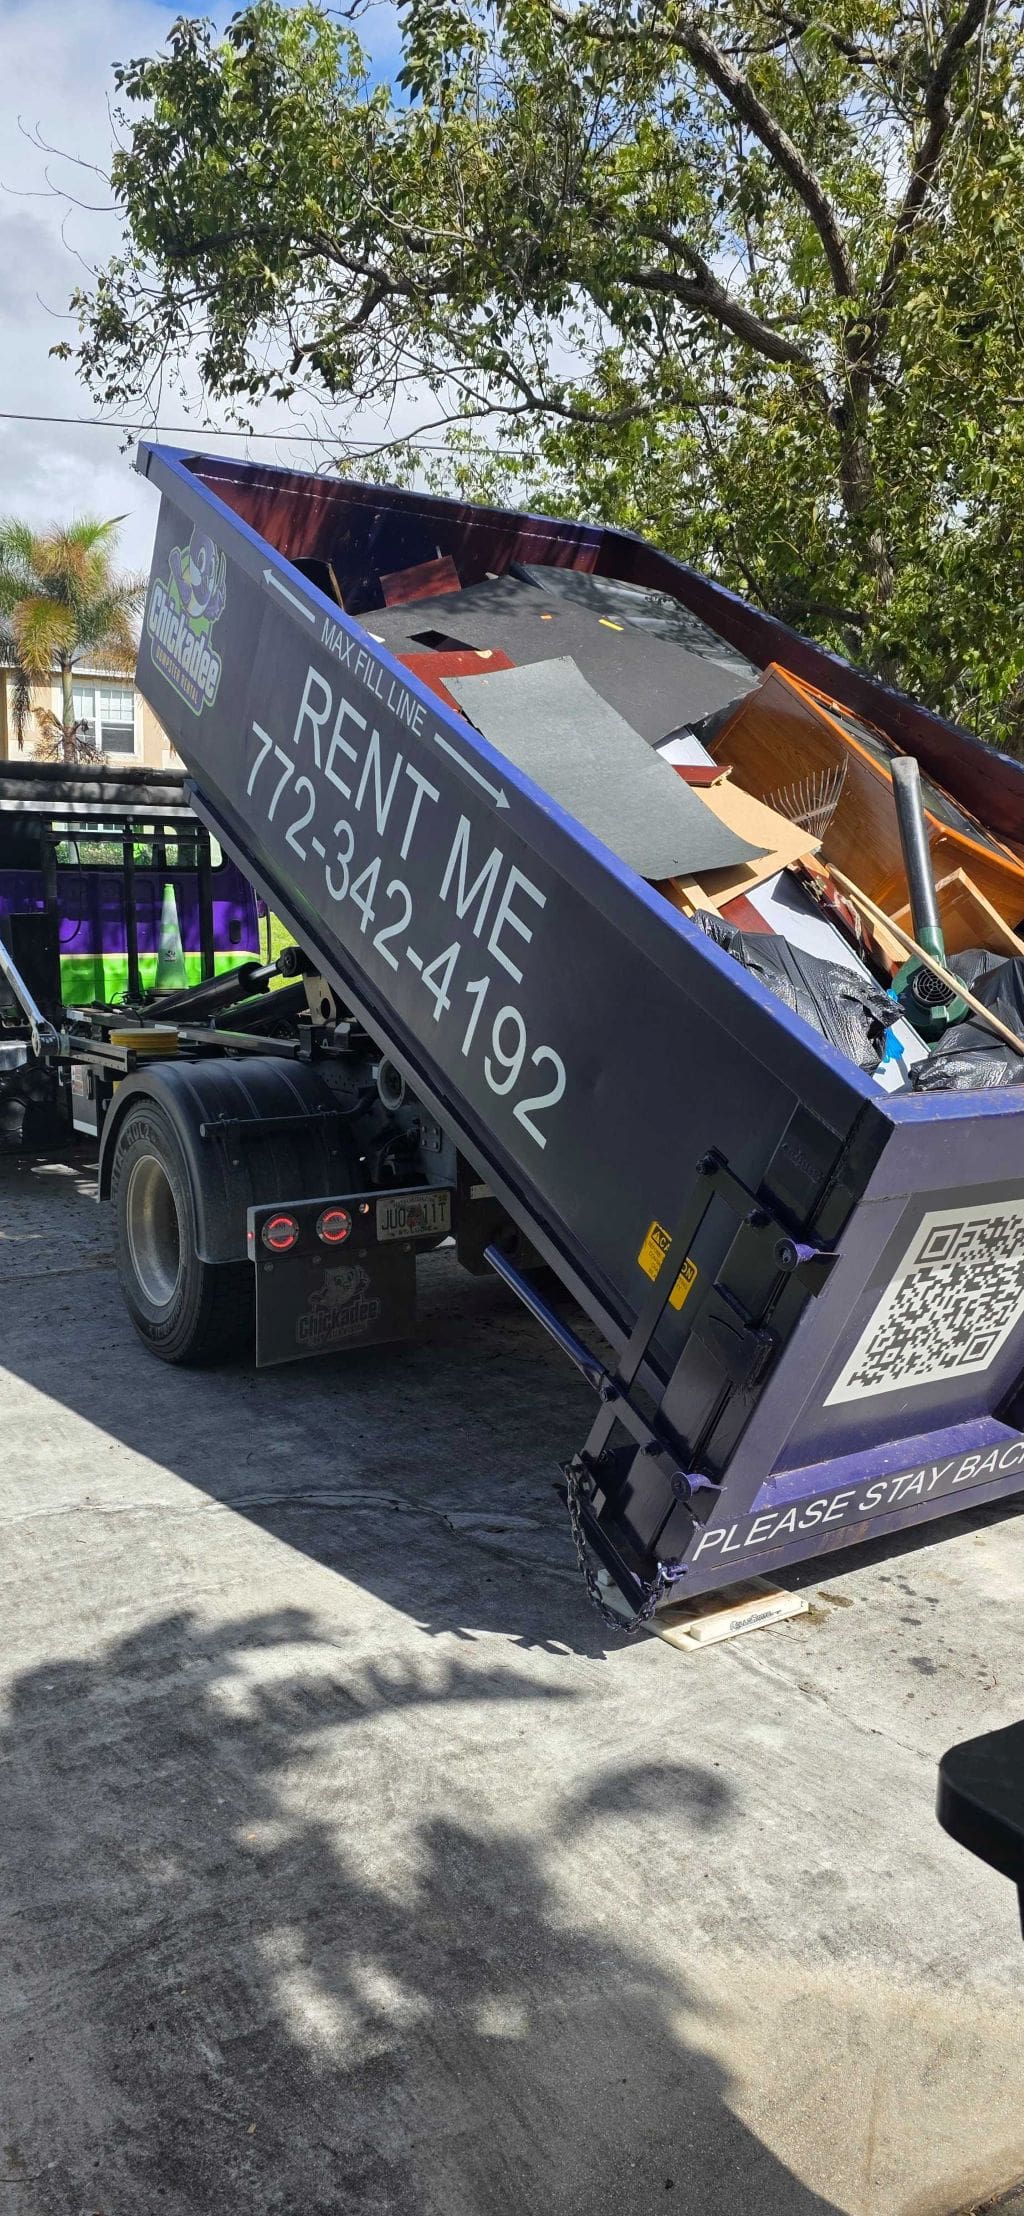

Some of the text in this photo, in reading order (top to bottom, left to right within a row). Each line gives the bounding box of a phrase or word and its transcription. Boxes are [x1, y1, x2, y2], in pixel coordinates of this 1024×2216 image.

[150, 586, 220, 699] Chickadee
[155, 646, 181, 684] DUMPSTER
[321, 617, 427, 736] MAX FILL LINE
[293, 666, 547, 984] RENT ME
[246, 721, 567, 1150] 772-342-4192
[692, 1441, 1024, 1562] PLEASE STAY BAC
